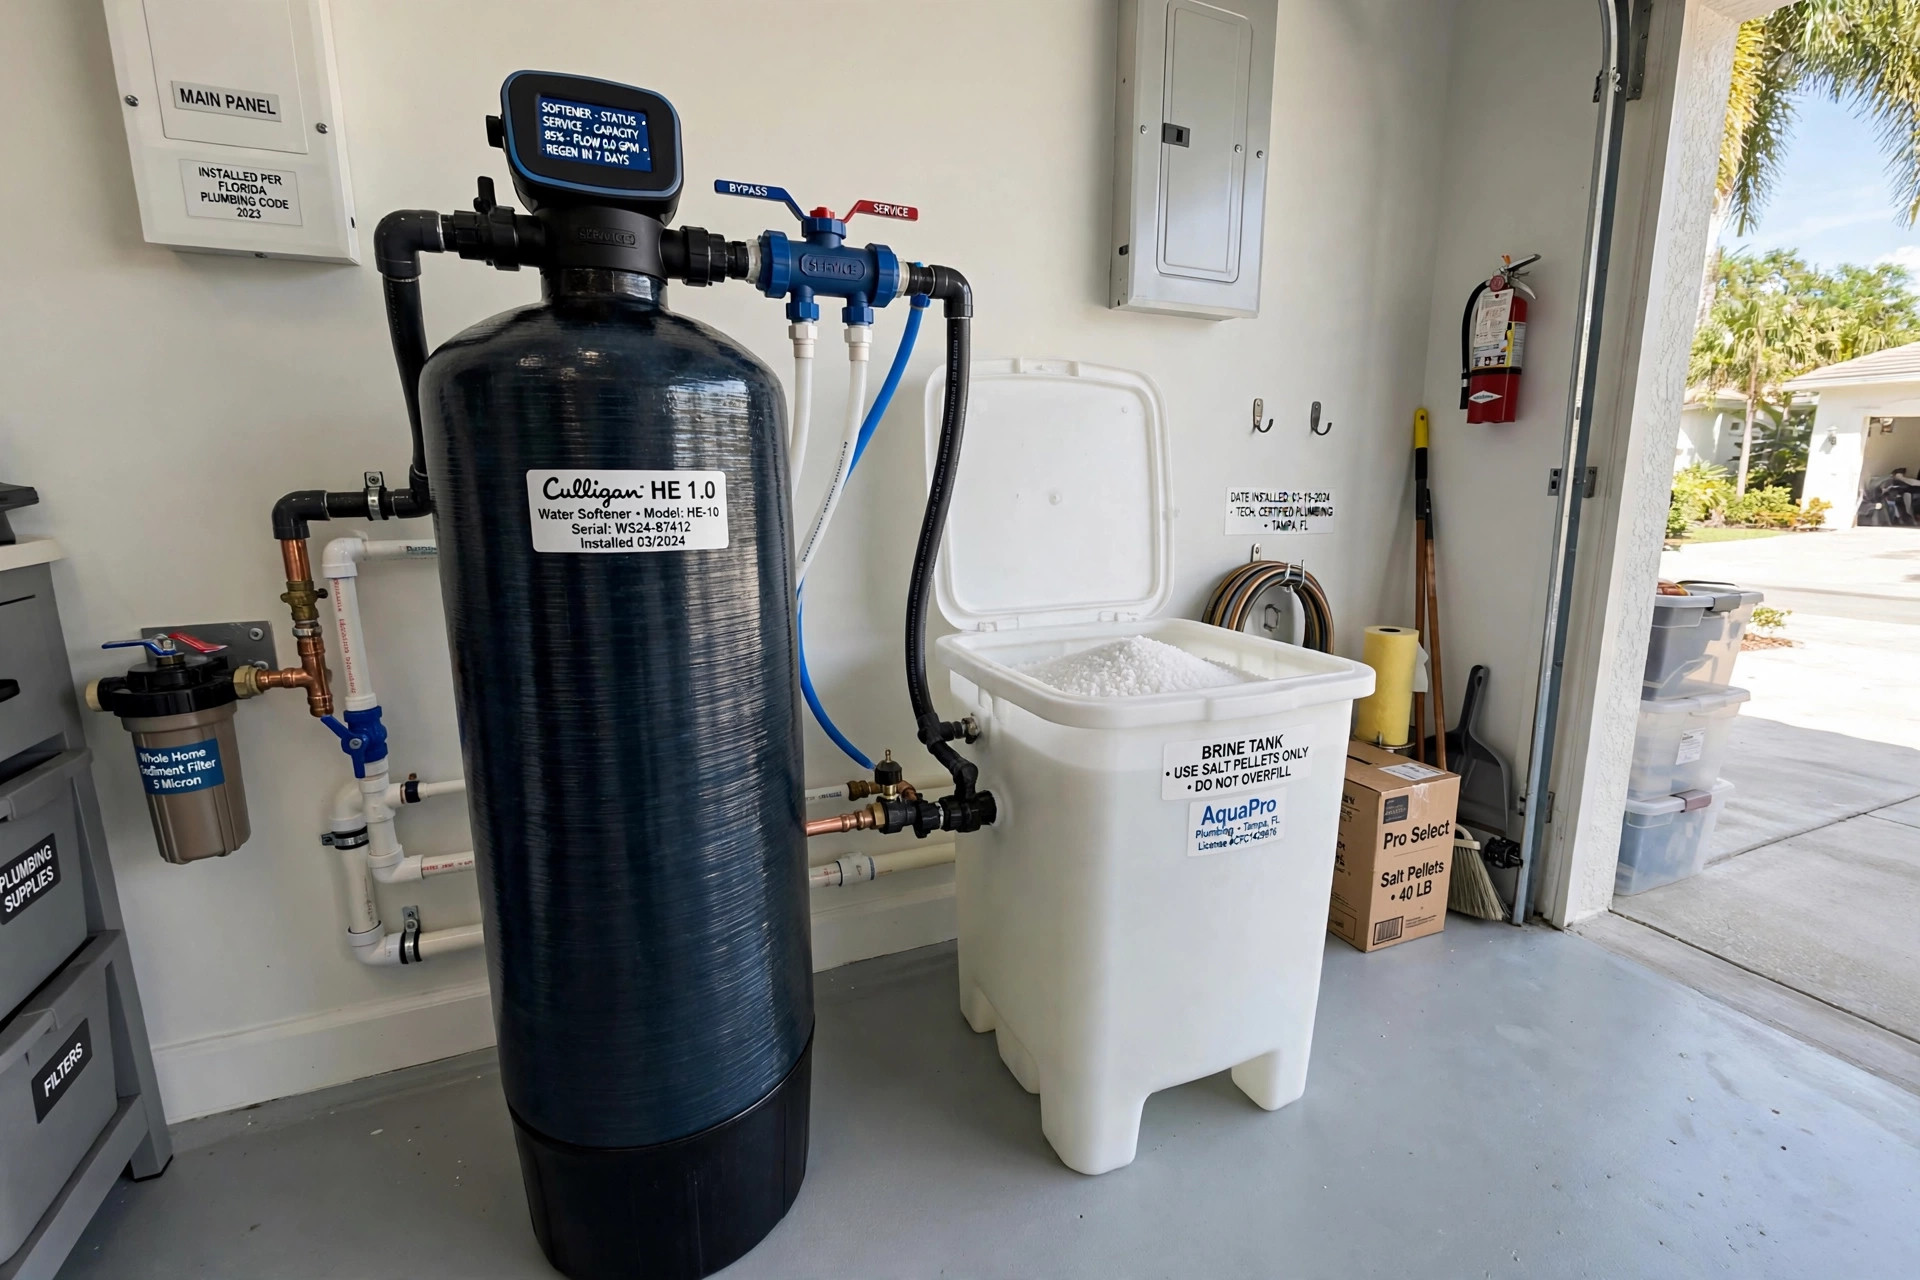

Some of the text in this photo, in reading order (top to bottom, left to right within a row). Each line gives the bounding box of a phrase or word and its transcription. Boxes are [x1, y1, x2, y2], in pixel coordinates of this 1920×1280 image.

[180, 88, 276, 115] MAIN PANEL
[541, 102, 636, 126] SOFTENER STATUS
[543, 116, 639, 140] SERVICE CAPACITY
[573, 133, 600, 148] FLOW
[618, 141, 639, 154] GPM
[546, 144, 630, 165] REGEN IN 7 DAYS
[198, 166, 282, 185] INSTALLED PER
[218, 181, 267, 196] FLORIDA
[729, 183, 768, 197] BYPASS
[200, 192, 289, 209] PLUMBING CODE
[873, 203, 909, 218] SERVICE
[236, 207, 262, 219] 2023
[542, 476, 716, 508] Culligan HE 1.0
[1230, 492, 1249, 502] DATE
[538, 507, 719, 520] Water Softener Model: HE-10
[572, 521, 691, 535] Serial: WS24-87412
[581, 535, 686, 549] Installed 03/2024
[140, 749, 206, 763] Whole Home
[1201, 734, 1284, 760] BRINE TANK
[187, 759, 216, 773] Filter
[1174, 746, 1309, 779] USE SALT PELLETS ONLY
[153, 776, 202, 789] 5 Micron
[1195, 765, 1291, 792] DO NOT OVERFILL
[1201, 799, 1277, 828] AquaPro
[1271, 815, 1280, 825] FL
[1383, 819, 1450, 850] Pro Select
[0, 845, 52, 894] PLUMBING
[1380, 860, 1444, 888] Salt Pellets
[4, 866, 54, 913] SUPPLIES
[1399, 880, 1432, 901] 40 LB
[43, 1041, 83, 1098] FILTERS
